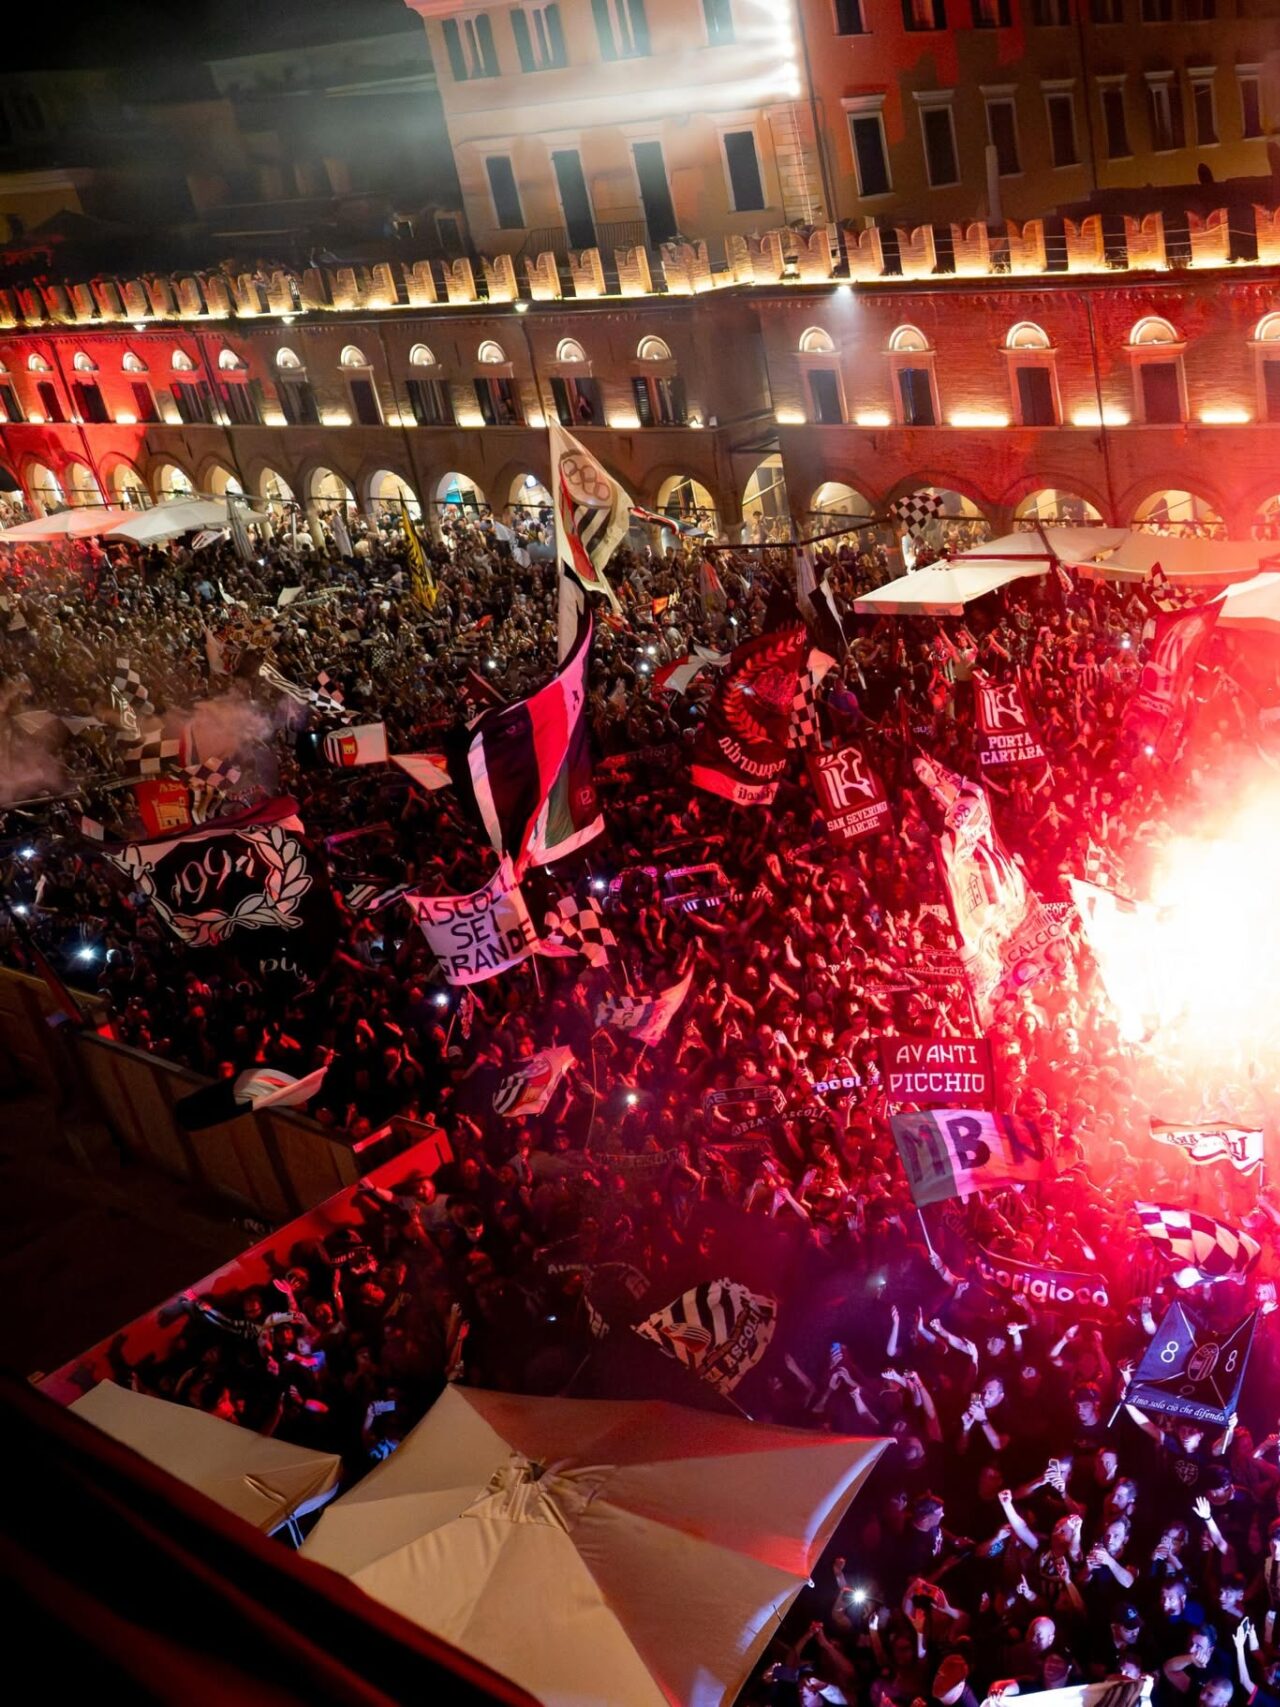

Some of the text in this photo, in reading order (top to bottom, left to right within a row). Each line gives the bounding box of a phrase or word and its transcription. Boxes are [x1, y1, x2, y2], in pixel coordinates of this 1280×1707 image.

[988, 732, 1033, 749] PORTA
[980, 744, 1046, 765] CARTARA
[827, 819, 846, 832] SAN
[843, 817, 881, 839] MARCHE
[452, 911, 501, 949] SEI
[895, 1043, 978, 1065] AVANTI
[888, 1071, 987, 1094] PICCHIO
[1160, 1340, 1180, 1364] 8
[1224, 1349, 1239, 1373] 8
[1150, 1399, 1166, 1411] solo
[1179, 1403, 1195, 1416] che
[1193, 1406, 1226, 1422] difendo
